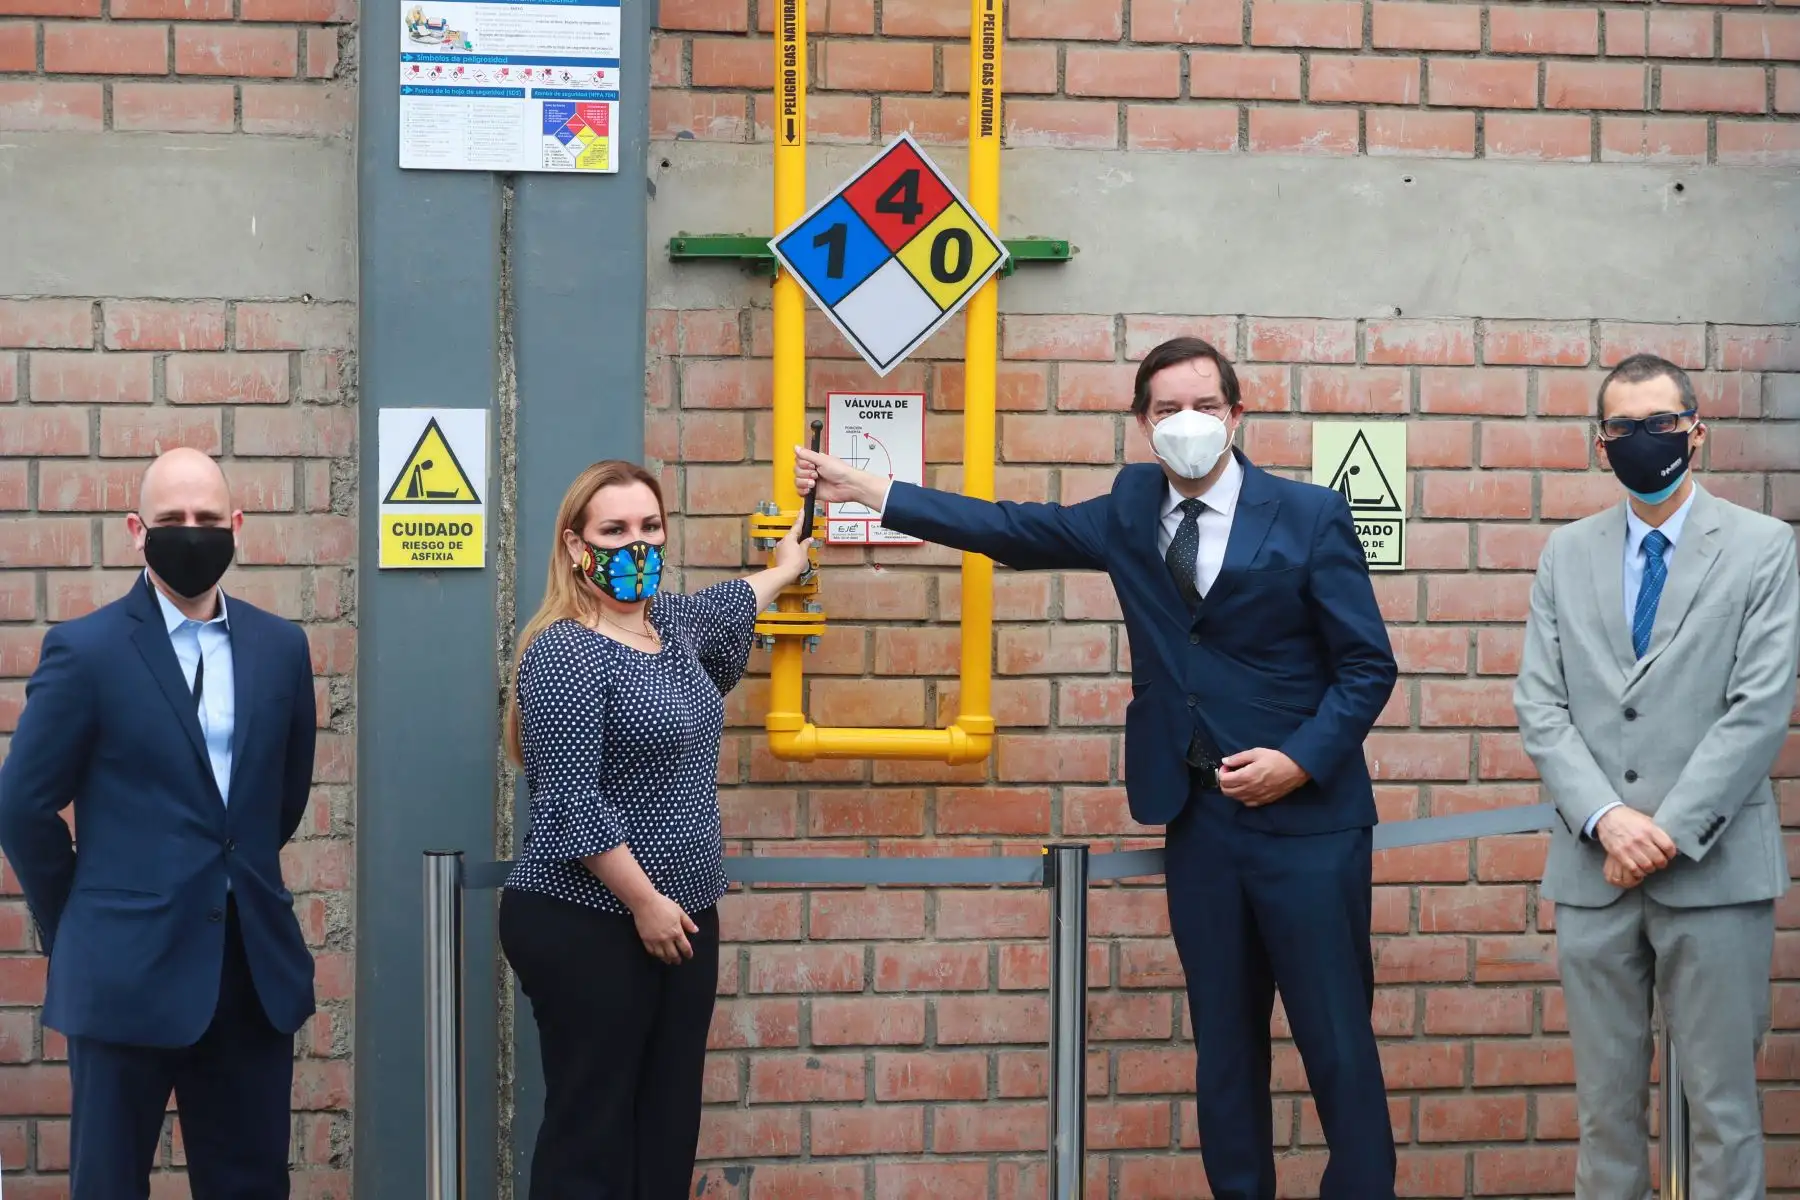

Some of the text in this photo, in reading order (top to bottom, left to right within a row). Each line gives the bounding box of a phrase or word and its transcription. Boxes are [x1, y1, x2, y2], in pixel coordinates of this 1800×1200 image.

[784, 0, 796, 115] PELIGRO GAS NATURA
[981, 14, 995, 137] PELIGRO GAS NATURAL
[875, 169, 924, 225] 4
[813, 223, 974, 284] 1 0
[845, 398, 908, 408] VÁLVULA DE
[859, 411, 893, 419] CORTE
[392, 523, 473, 536] CUIDADO
[1354, 525, 1393, 536] DADO
[402, 541, 463, 550] RIESGO DE
[411, 552, 454, 560] ASFIXIA
